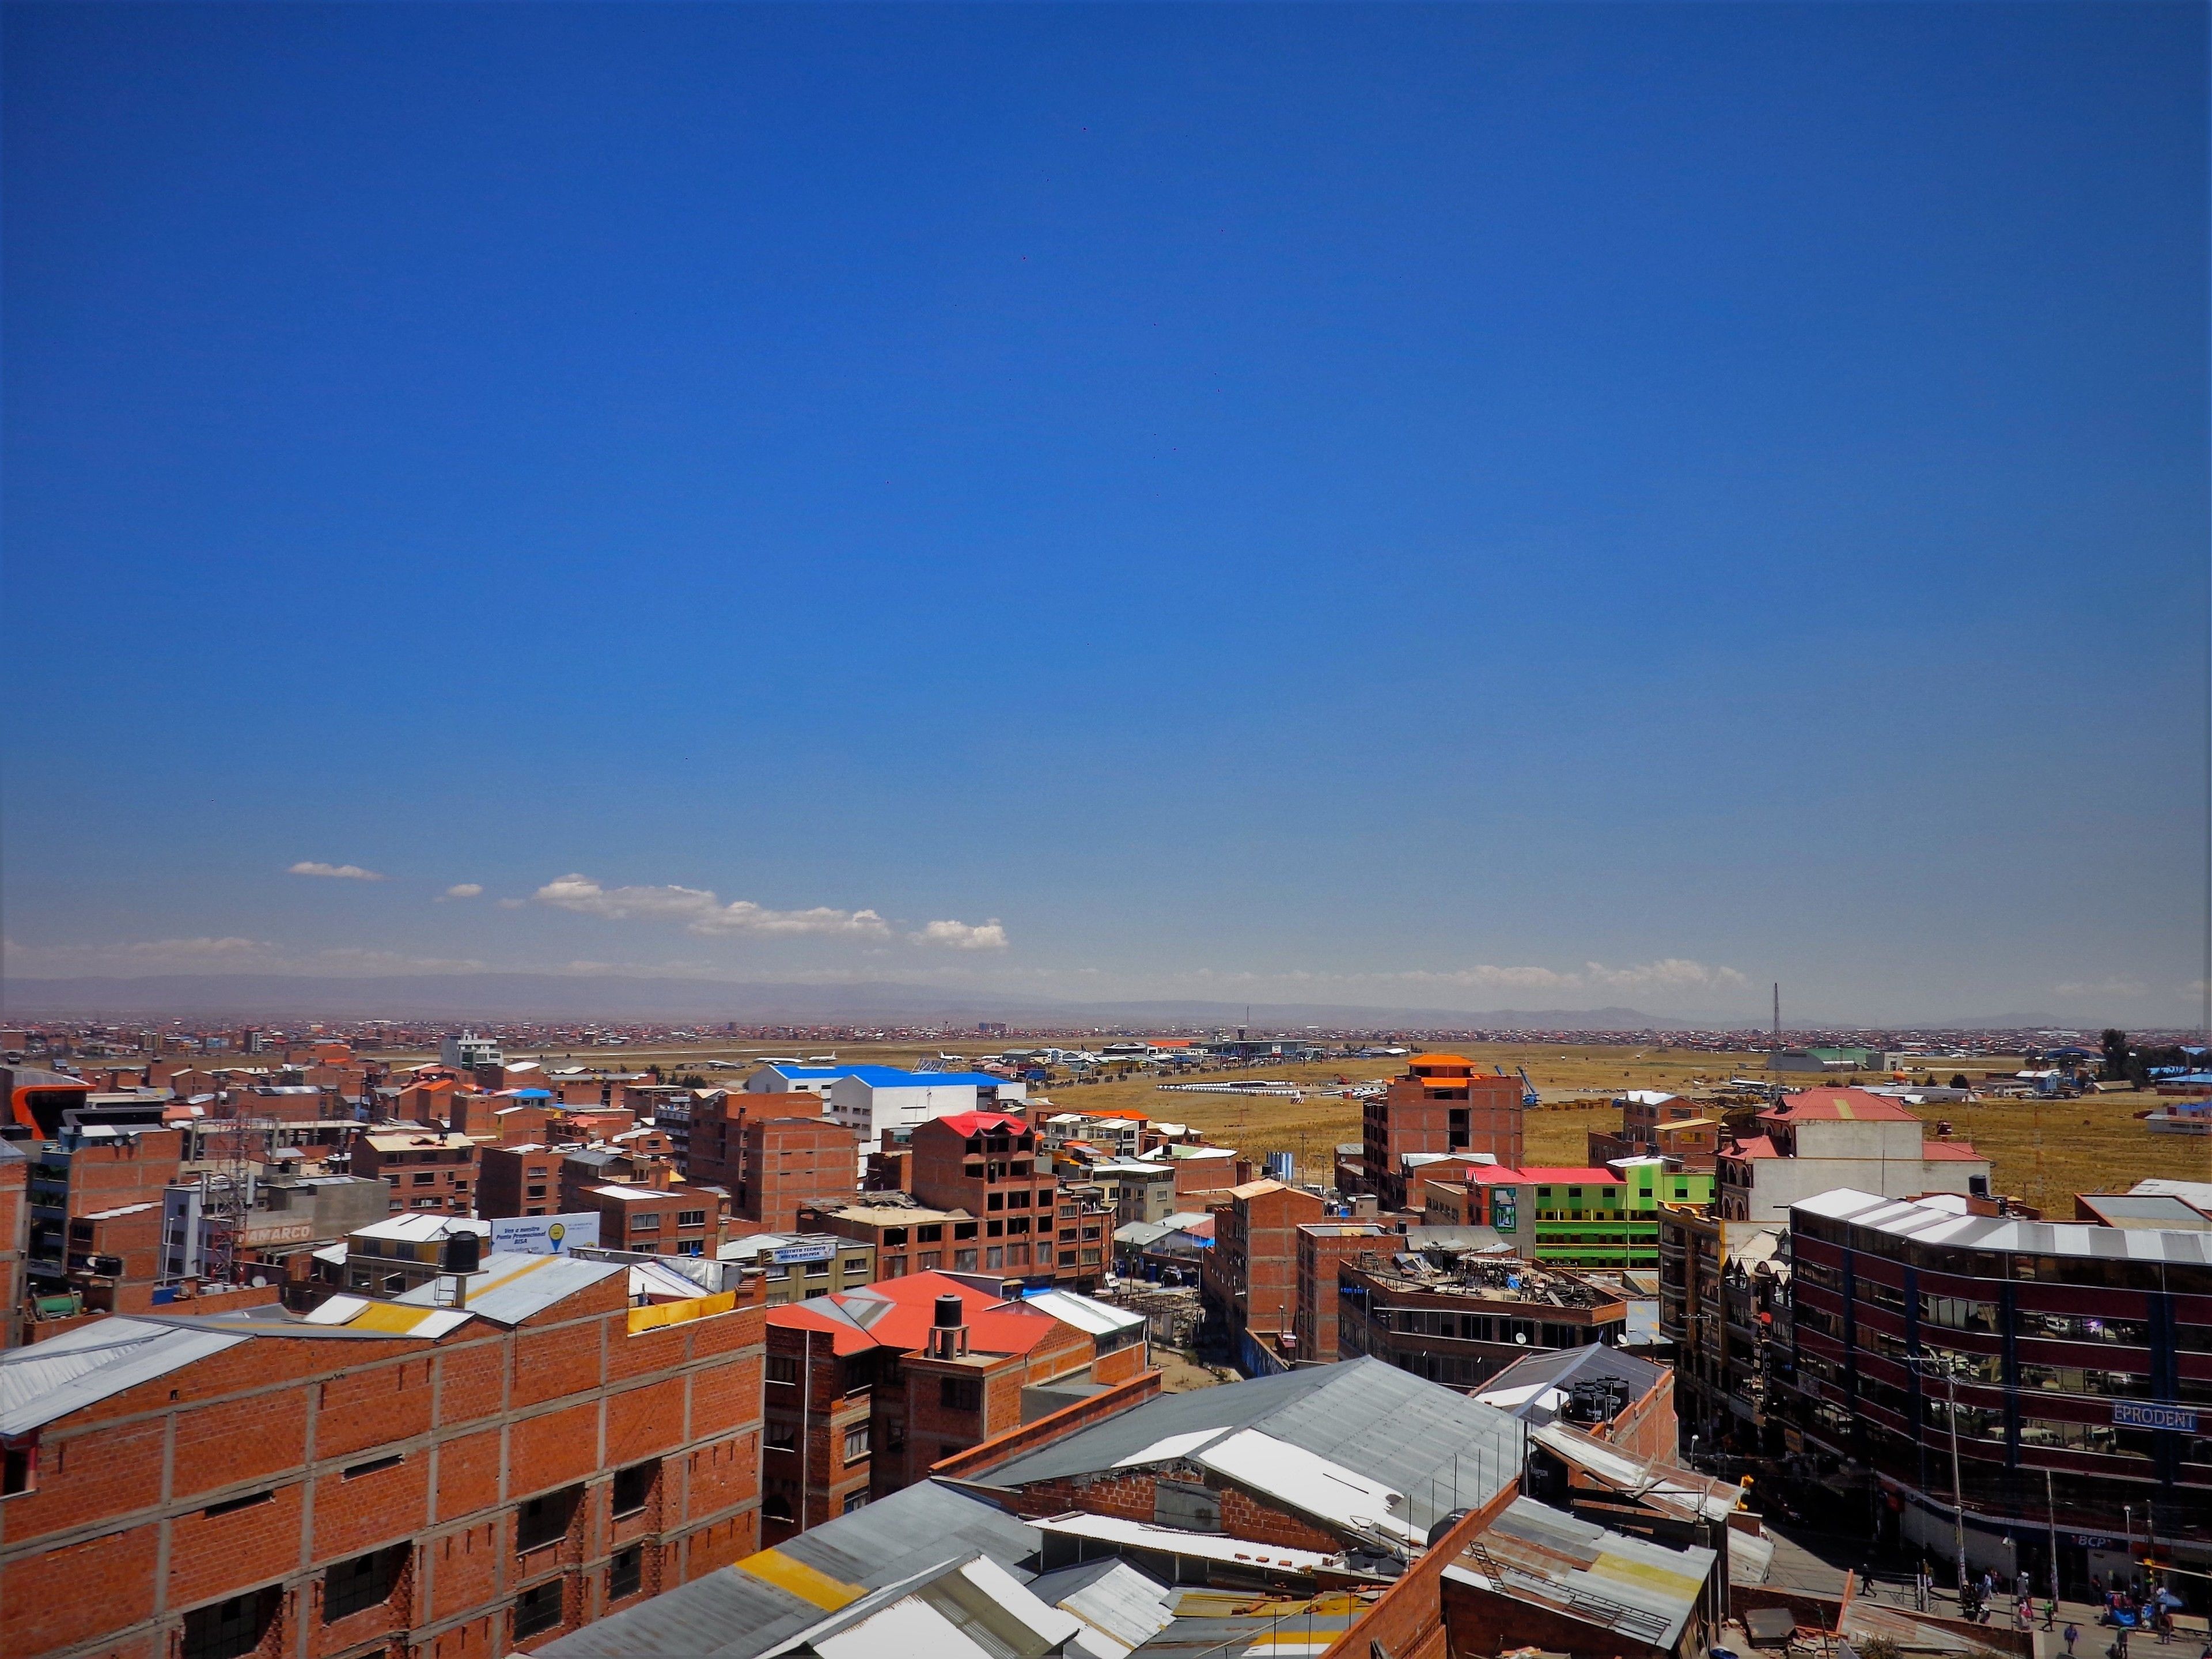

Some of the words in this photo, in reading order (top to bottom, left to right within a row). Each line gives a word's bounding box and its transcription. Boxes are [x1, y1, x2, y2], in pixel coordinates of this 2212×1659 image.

[513, 1230, 546, 1239] Promocional
[2114, 1404, 2195, 1428] EPRODENT
[2078, 1535, 2107, 1547] BCP
